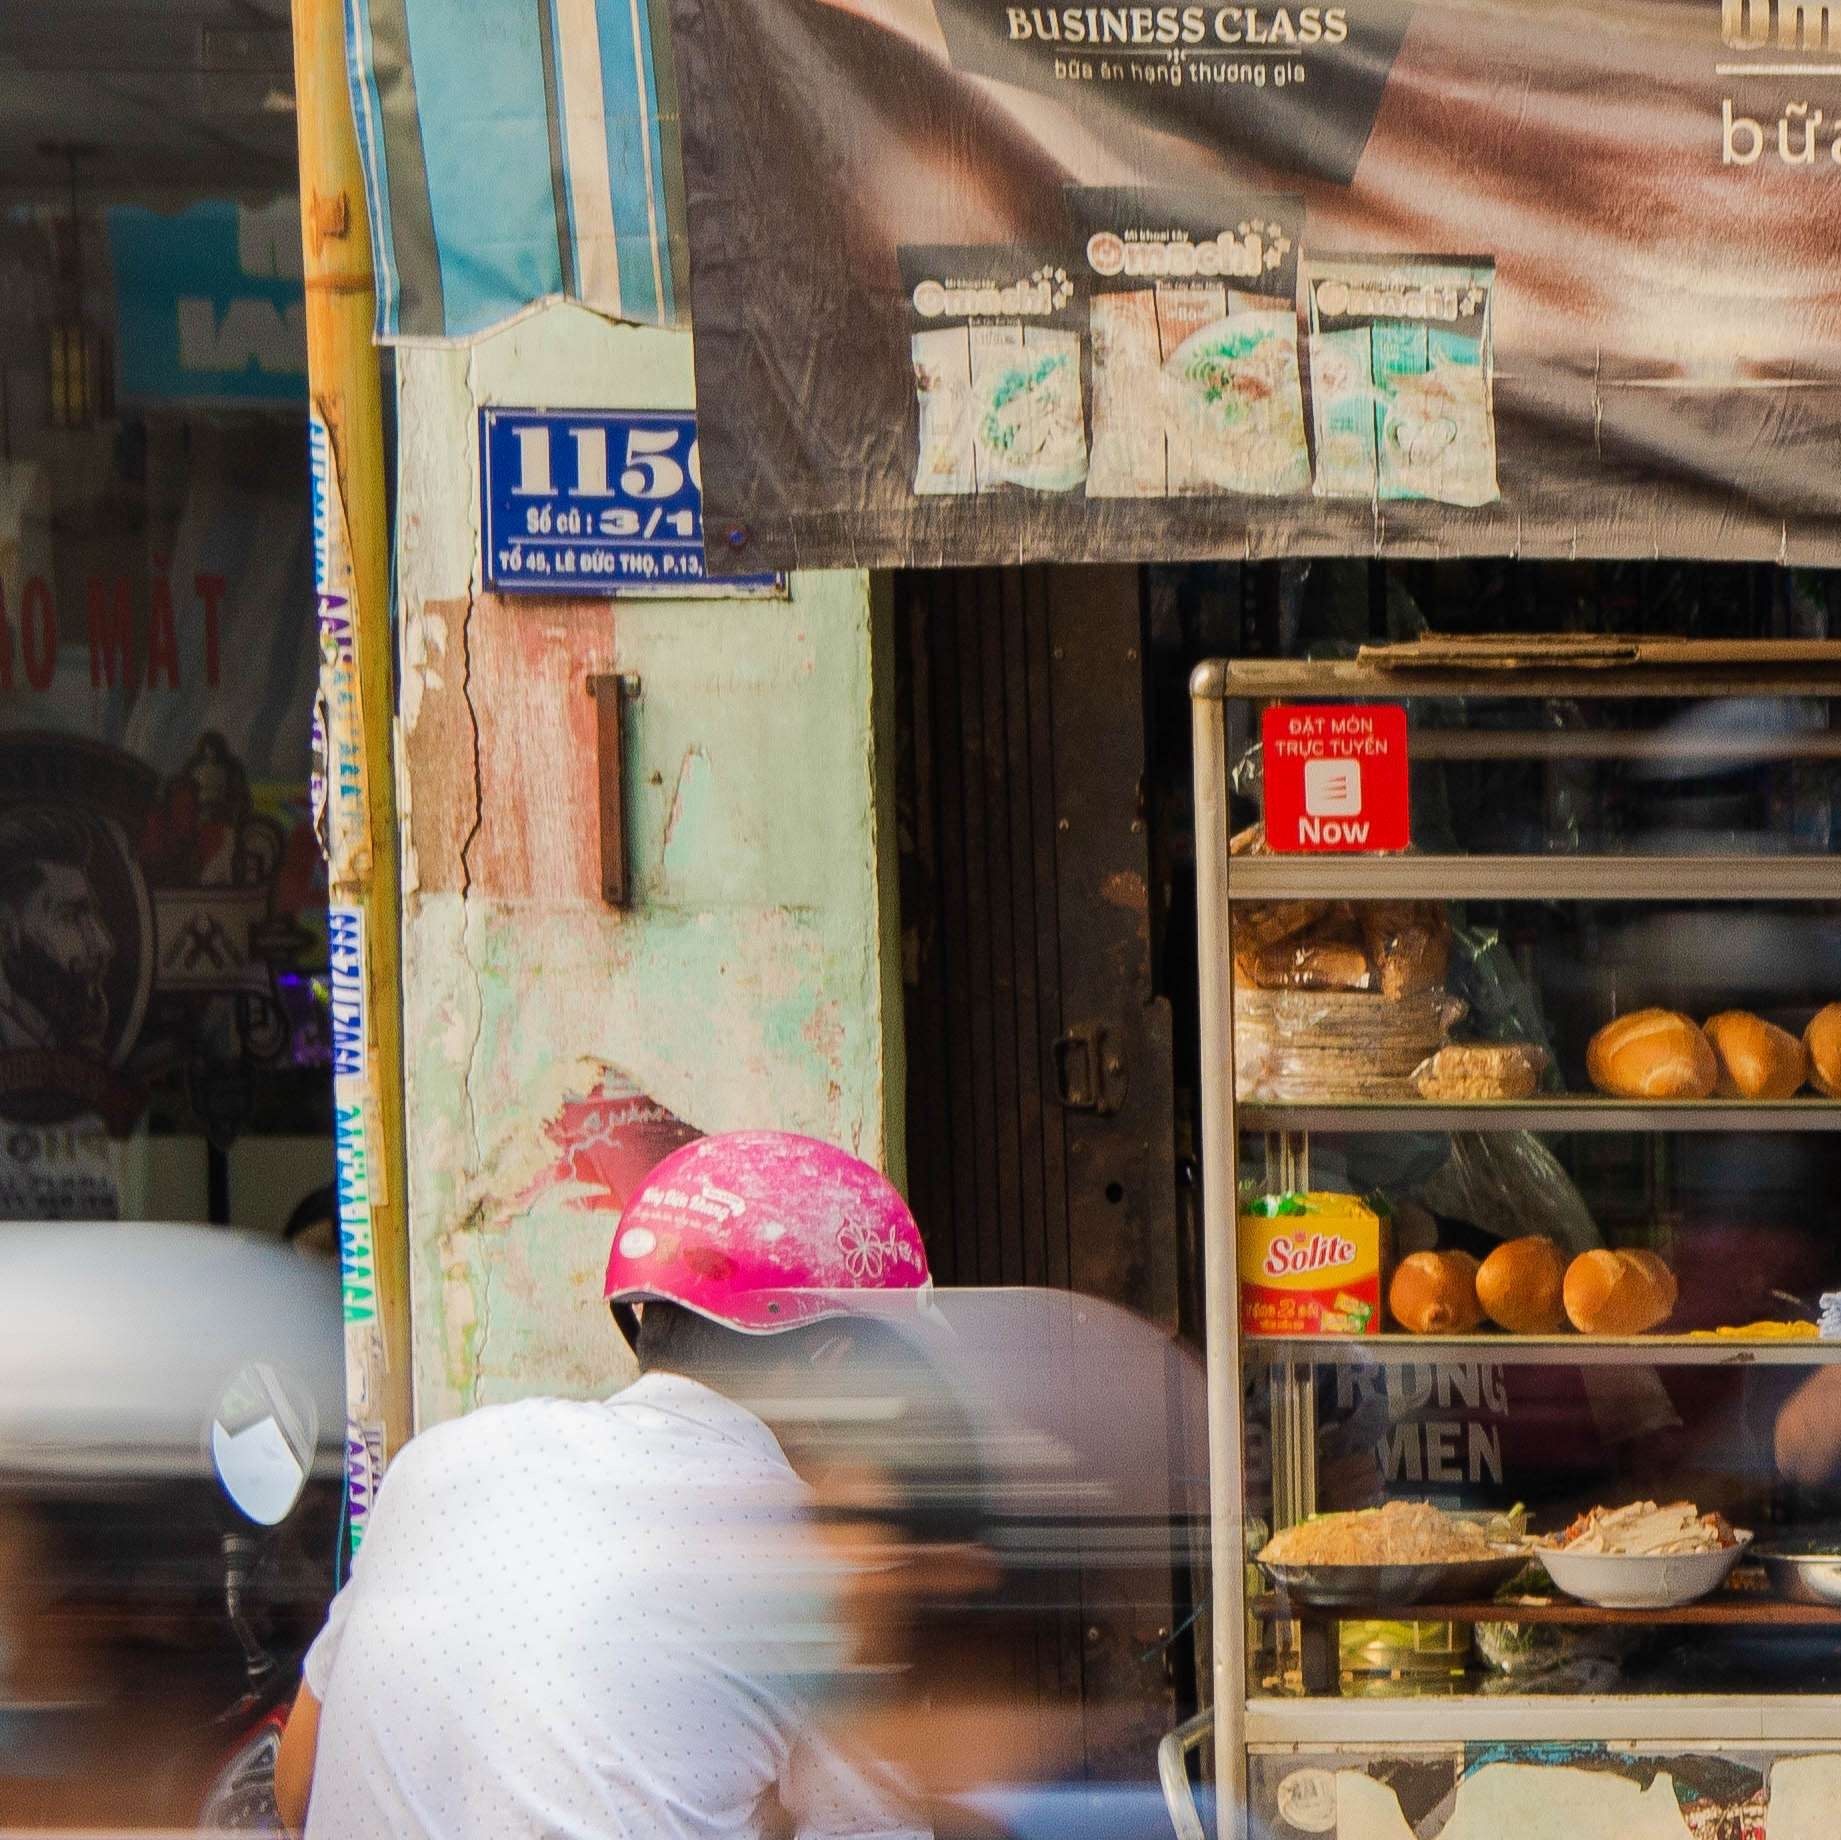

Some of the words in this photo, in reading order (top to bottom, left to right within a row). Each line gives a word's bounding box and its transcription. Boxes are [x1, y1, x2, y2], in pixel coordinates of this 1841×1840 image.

[1006, 7, 1204, 43] BUSINESS
[1214, 8, 1348, 43] CLASS
[511, 426, 702, 499] 115
[600, 506, 703, 539] 3/1
[1289, 715, 1325, 738] ĐẶT
[1331, 714, 1374, 735] MÓN
[1328, 735, 1389, 756] TUYẾN
[1298, 816, 1371, 845] Now
[1264, 1233, 1356, 1276] Solite
